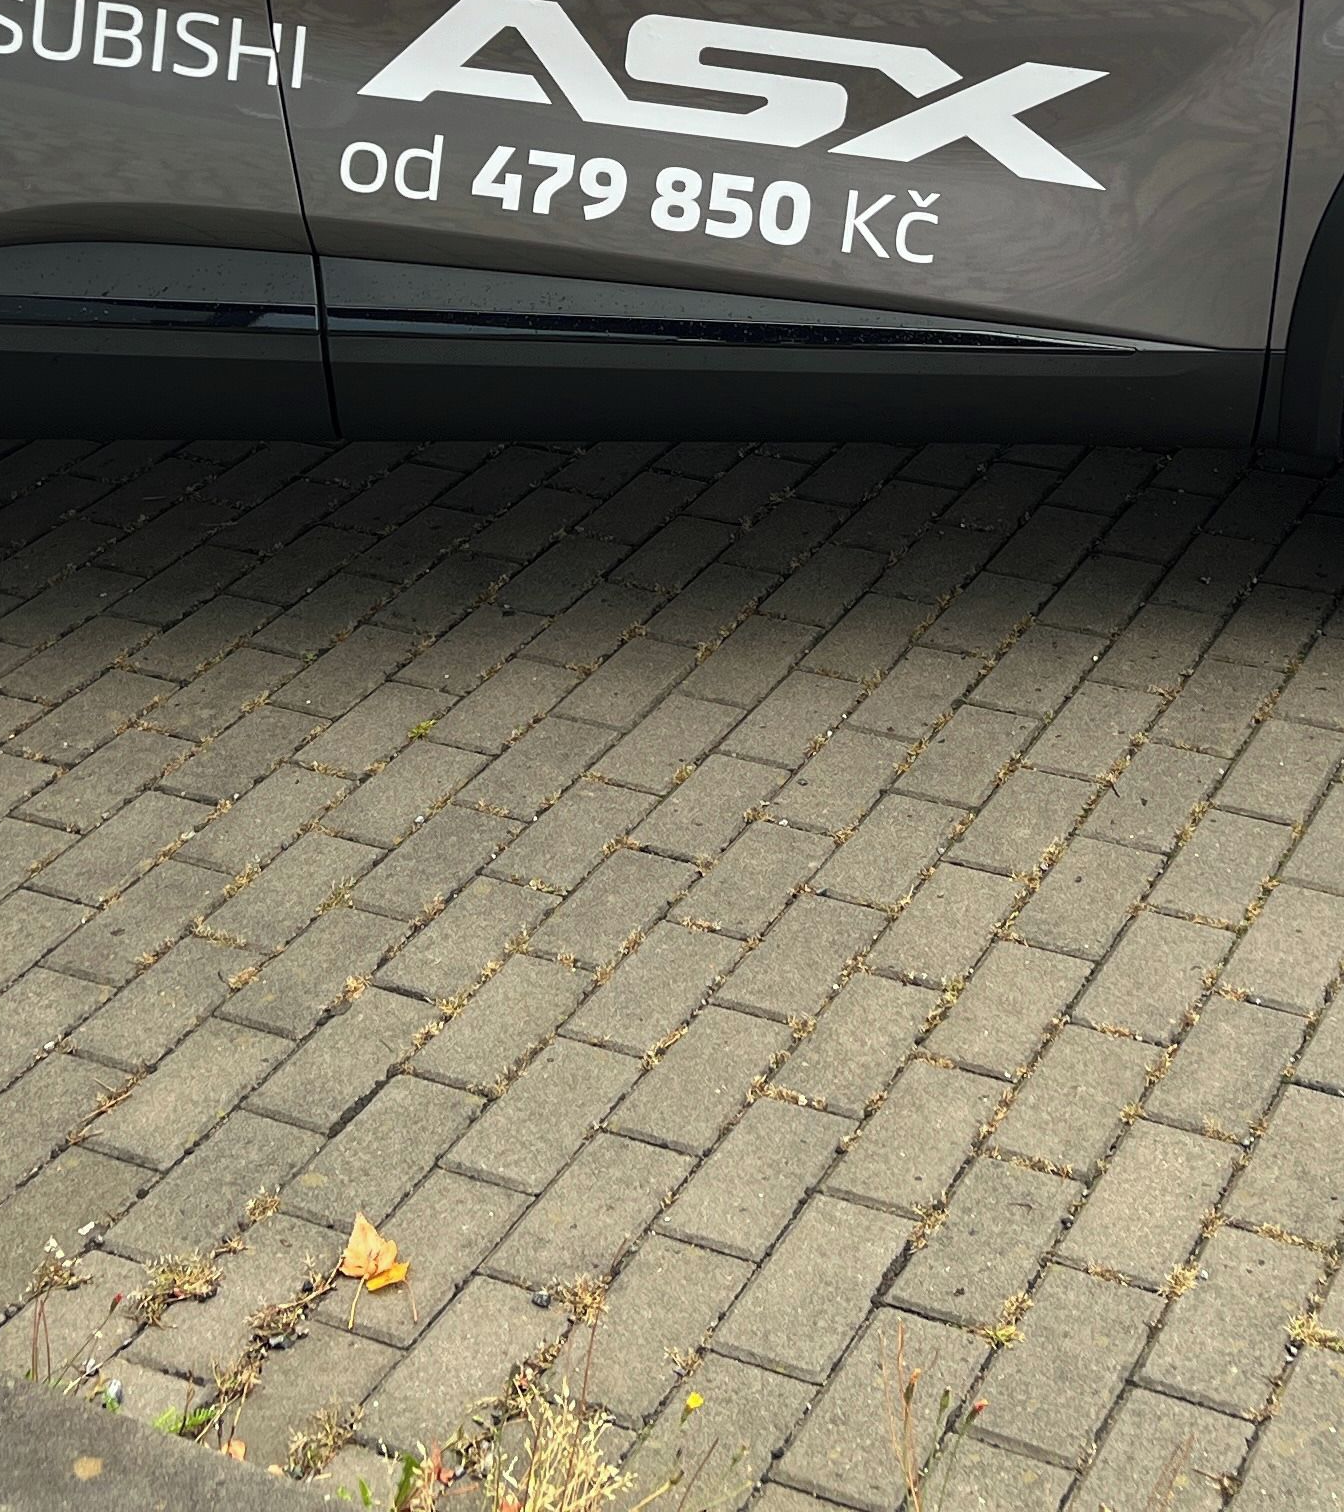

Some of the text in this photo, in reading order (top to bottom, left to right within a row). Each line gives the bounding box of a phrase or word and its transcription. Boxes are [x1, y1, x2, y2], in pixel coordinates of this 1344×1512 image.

[338, 134, 942, 265] od 479 850 Kč
